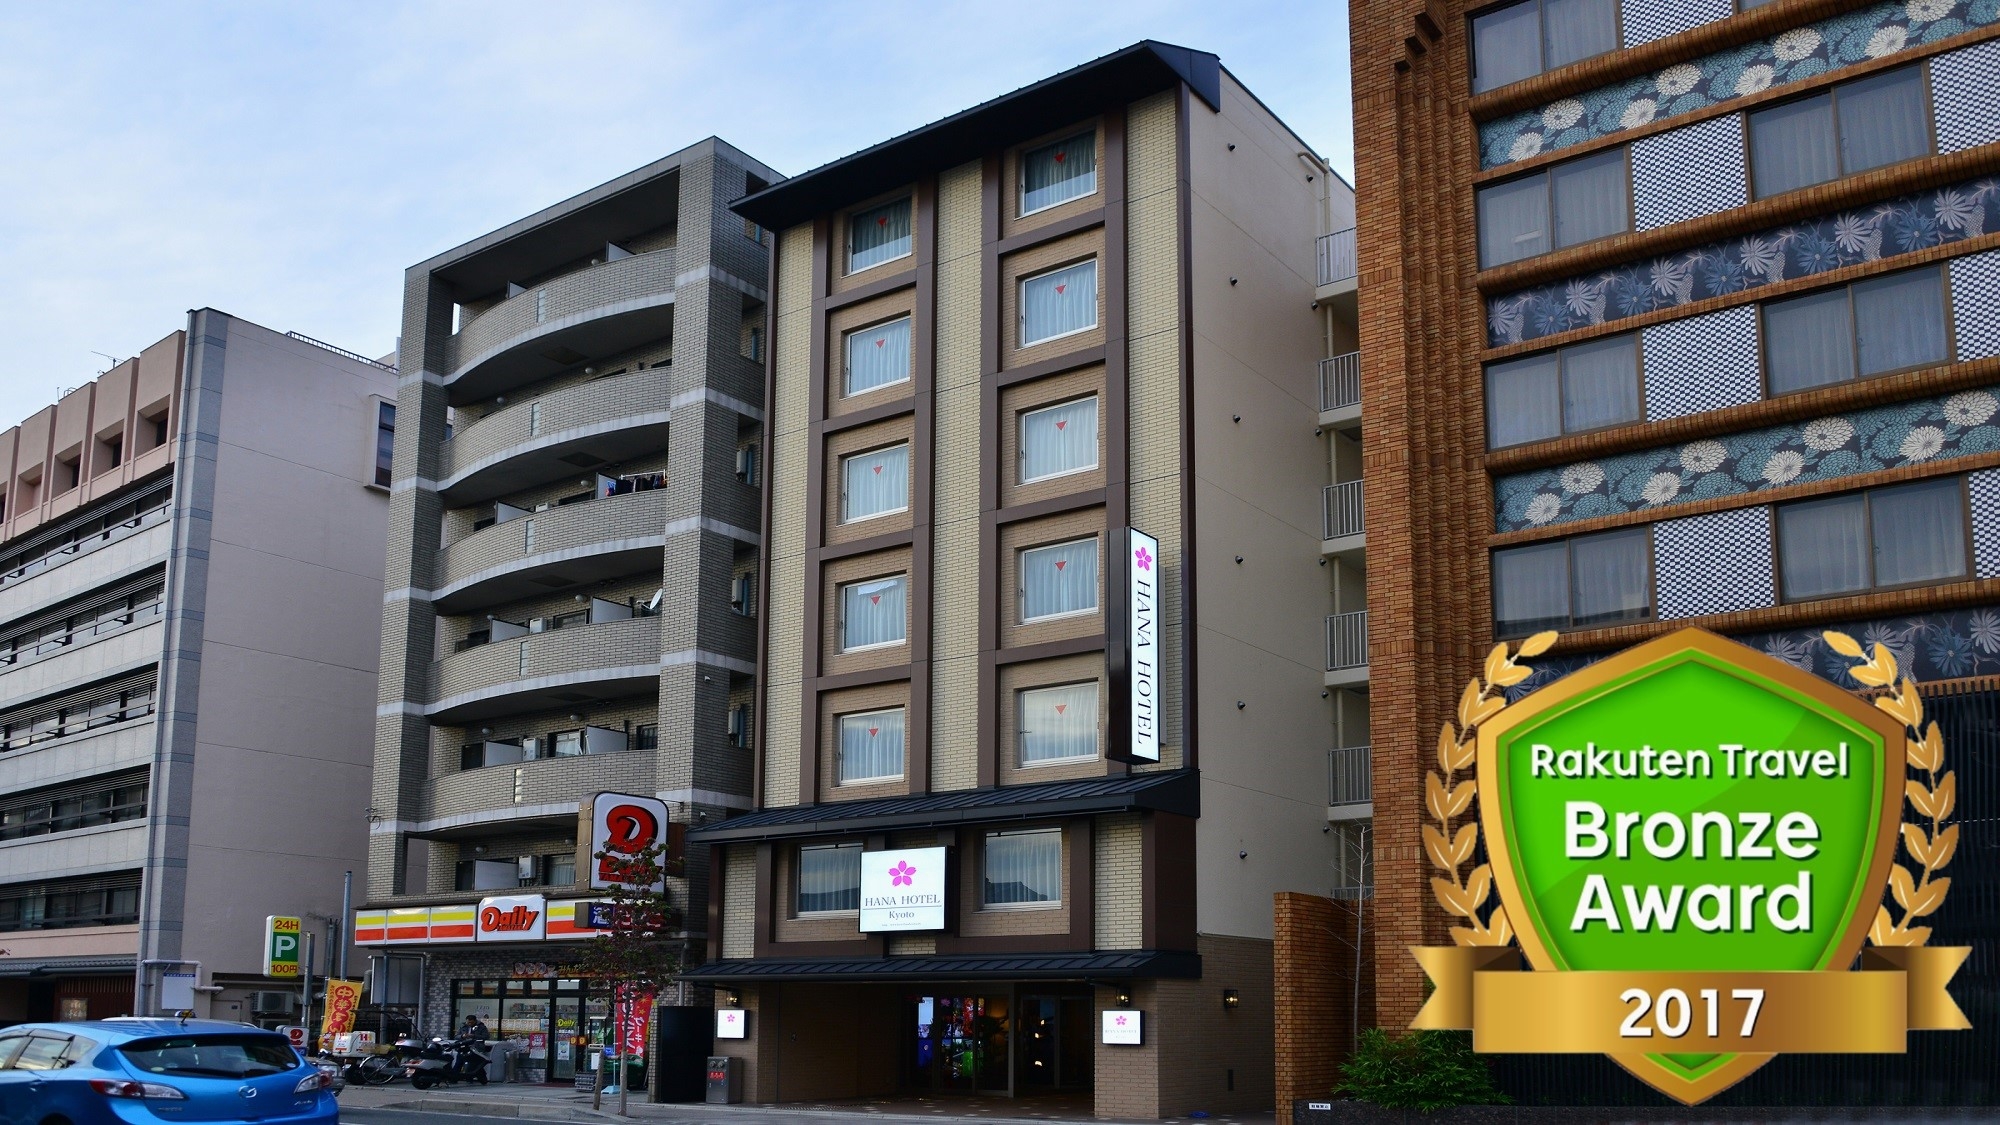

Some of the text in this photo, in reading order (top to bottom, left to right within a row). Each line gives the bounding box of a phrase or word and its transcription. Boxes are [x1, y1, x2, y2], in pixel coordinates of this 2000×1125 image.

[1137, 579, 1152, 744] HANA HOTEL
[865, 894, 941, 907] HANA HOTEL
[481, 905, 539, 932] Daily
[889, 910, 915, 921] Kyoto
[274, 919, 299, 930] 24H
[275, 935, 296, 958] P
[271, 964, 298, 974] 100円
